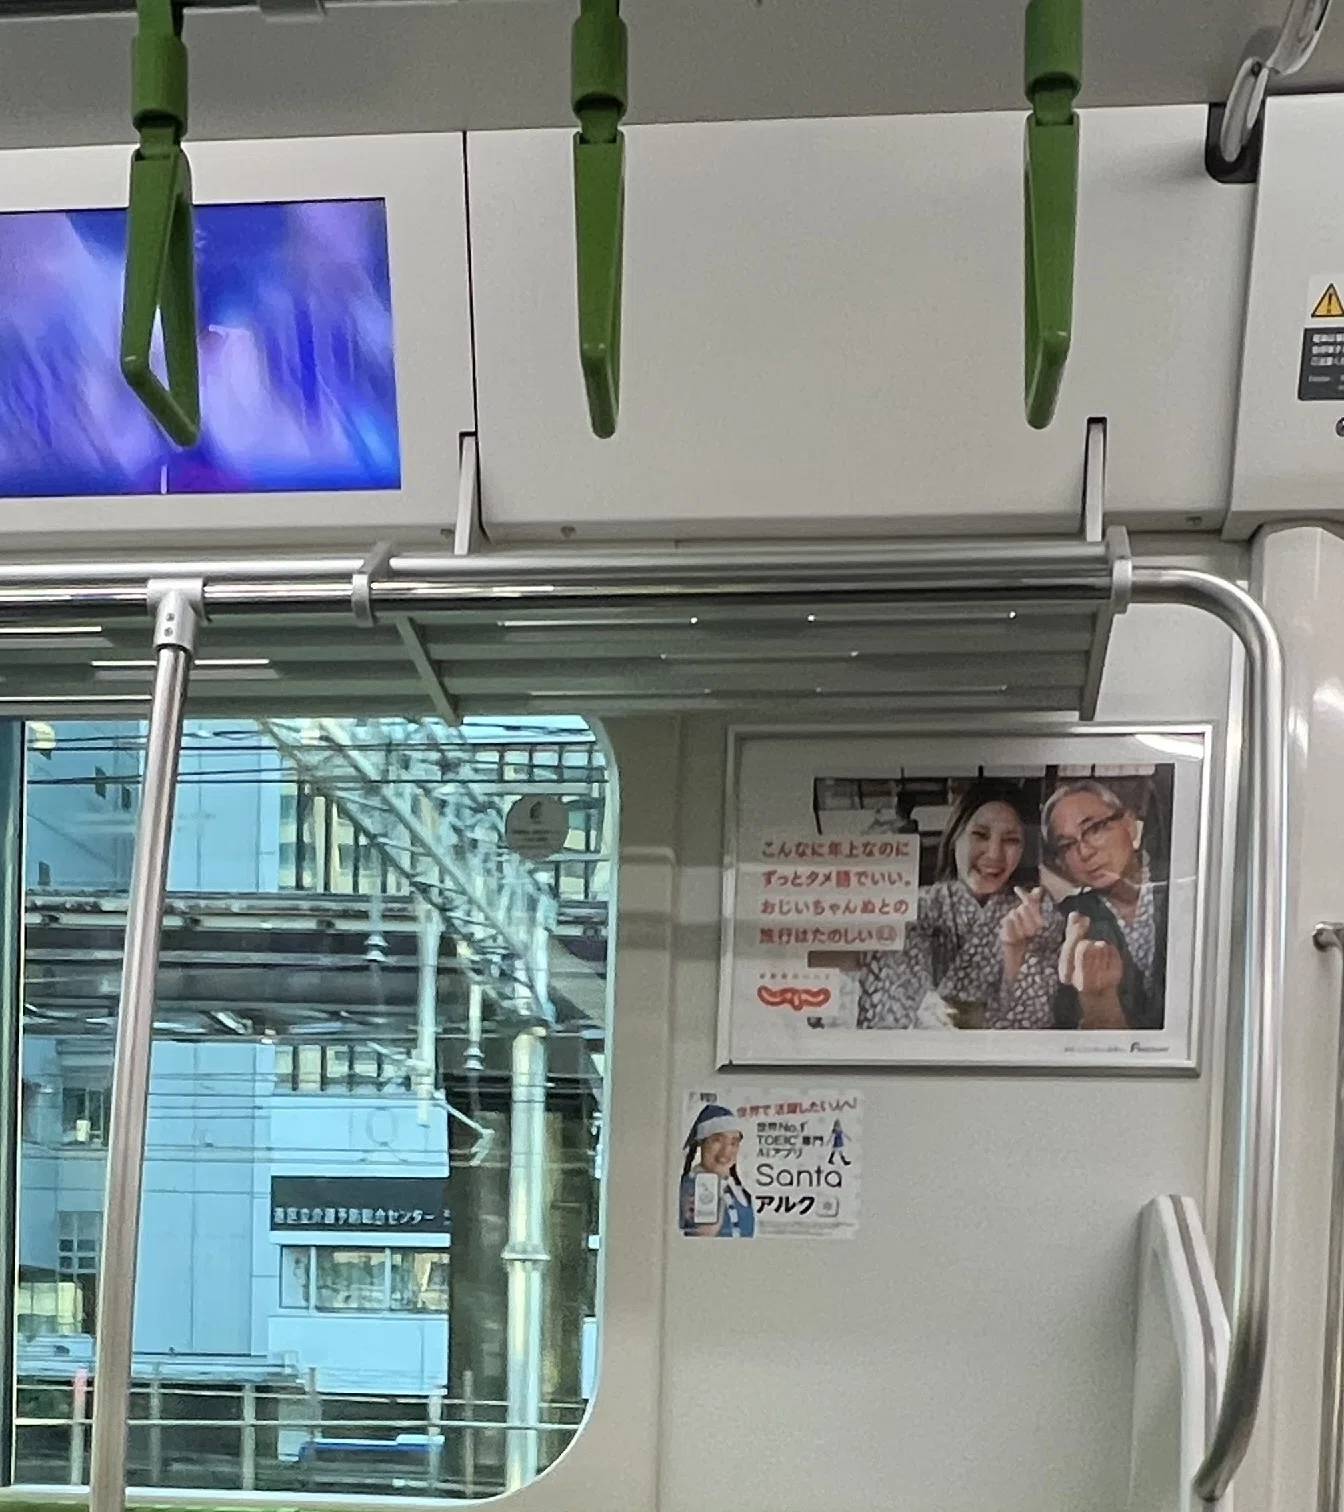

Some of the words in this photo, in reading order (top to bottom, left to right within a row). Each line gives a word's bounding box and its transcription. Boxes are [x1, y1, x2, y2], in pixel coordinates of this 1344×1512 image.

[762, 840, 910, 858] こんなに年上なのに
[756, 1163, 842, 1187] Santa
[756, 1195, 815, 1215] アルク
